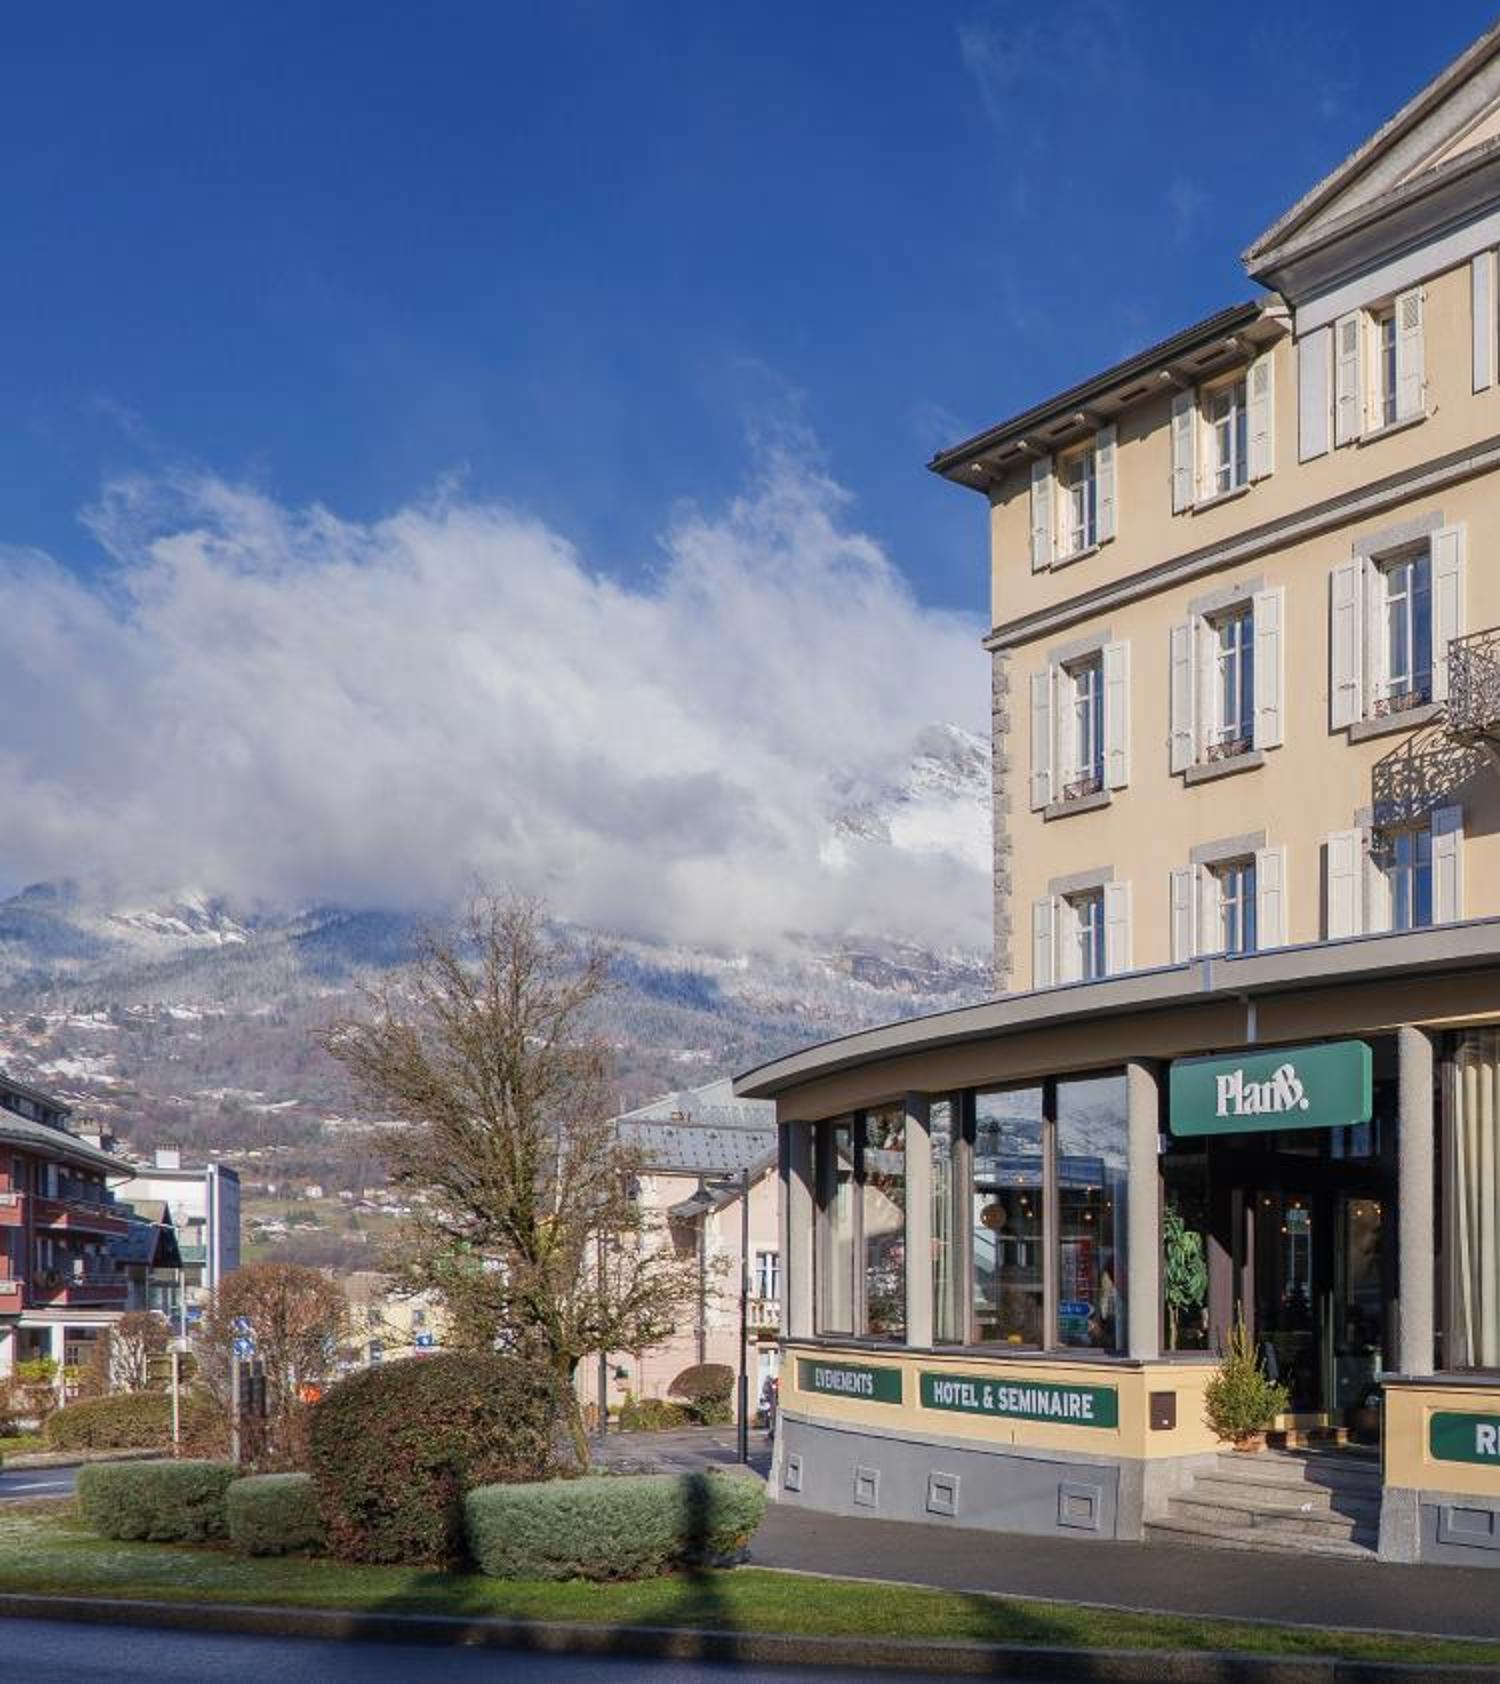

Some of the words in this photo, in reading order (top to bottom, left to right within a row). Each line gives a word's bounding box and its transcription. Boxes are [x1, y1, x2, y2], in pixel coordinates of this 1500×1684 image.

[815, 1367, 874, 1395] EVENEMENTS
[932, 1381, 979, 1408] HOTEL
[983, 1385, 994, 1409] &
[998, 1387, 1095, 1419] SEMINAIRE
